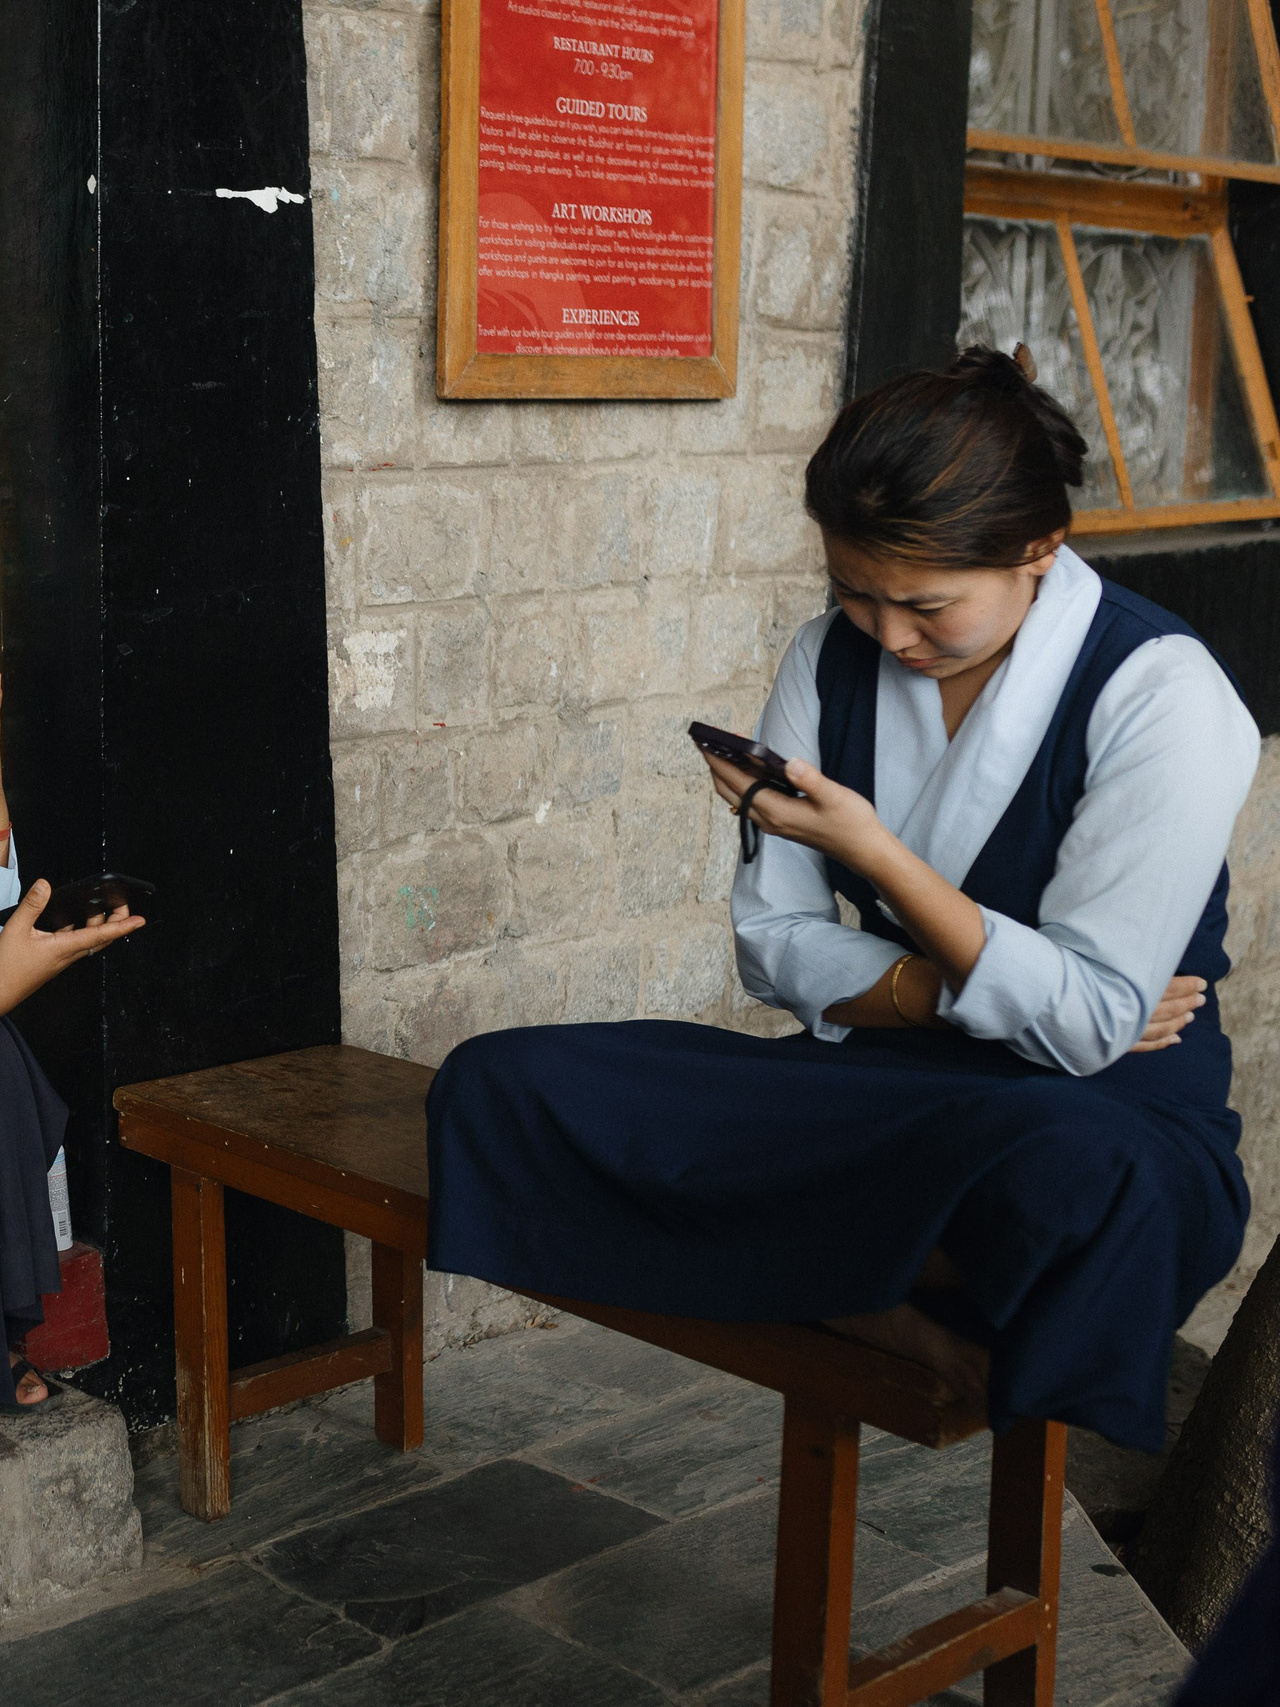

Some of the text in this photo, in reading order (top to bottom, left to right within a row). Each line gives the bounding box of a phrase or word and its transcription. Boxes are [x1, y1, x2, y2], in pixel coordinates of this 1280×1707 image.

[553, 36, 654, 64] RESTAURANT HOURS
[556, 97, 647, 123] GUIDED TOURS
[480, 124, 504, 136] Visitors
[506, 127, 516, 137] will
[518, 128, 527, 139] be
[528, 130, 542, 141] able
[543, 133, 549, 142] to
[551, 132, 575, 145] observe
[577, 135, 587, 146] the
[625, 141, 643, 153] forms
[644, 143, 650, 153] of
[508, 143, 532, 157] thangka
[563, 152, 570, 160] as
[572, 151, 584, 162] well
[586, 155, 593, 163] as
[595, 155, 605, 164] the
[639, 159, 650, 169] arts
[652, 158, 659, 169] of
[533, 163, 545, 173] and
[574, 165, 591, 178] Tours
[592, 169, 605, 179] take
[647, 172, 658, 184] 30
[552, 203, 652, 226] ART WORKSHOPS
[479, 216, 489, 228] For
[491, 217, 509, 230] those
[511, 222, 534, 233] wishing
[536, 224, 542, 232] to
[544, 224, 553, 235] try
[554, 223, 568, 234] their
[570, 223, 586, 235] hand
[587, 227, 593, 236] at
[595, 224, 616, 238] Tibetan
[479, 234, 513, 246] workshops
[515, 235, 523, 246] for
[525, 237, 545, 250] visiting
[546, 238, 577, 250] individuals
[578, 240, 589, 251] and
[614, 241, 631, 254] There
[479, 250, 512, 262] workshops
[514, 251, 526, 262] and
[528, 255, 548, 265] guests
[548, 256, 559, 264] are
[560, 256, 587, 266] welcome
[588, 258, 594, 267] to
[596, 259, 606, 269] join
[607, 256, 615, 268] for
[617, 261, 624, 269] as
[625, 260, 638, 271] long
[639, 262, 646, 270] as
[647, 260, 659, 270] their
[478, 264, 493, 277] offer
[495, 266, 530, 279] workshops
[532, 271, 537, 279] in
[539, 270, 563, 282] thangka
[593, 272, 610, 283] wood
[678, 277, 689, 287] and
[562, 308, 640, 326] EXPERIENCES
[478, 324, 496, 336] Travel
[497, 326, 510, 337] with
[523, 326, 540, 340] lovely
[540, 329, 554, 338] tour
[555, 330, 574, 341] guides
[584, 328, 595, 340] half
[596, 332, 603, 340] or
[604, 333, 615, 341] one
[616, 330, 626, 342] day
[516, 342, 542, 354] discover
[543, 343, 553, 354] the
[579, 344, 590, 354] and
